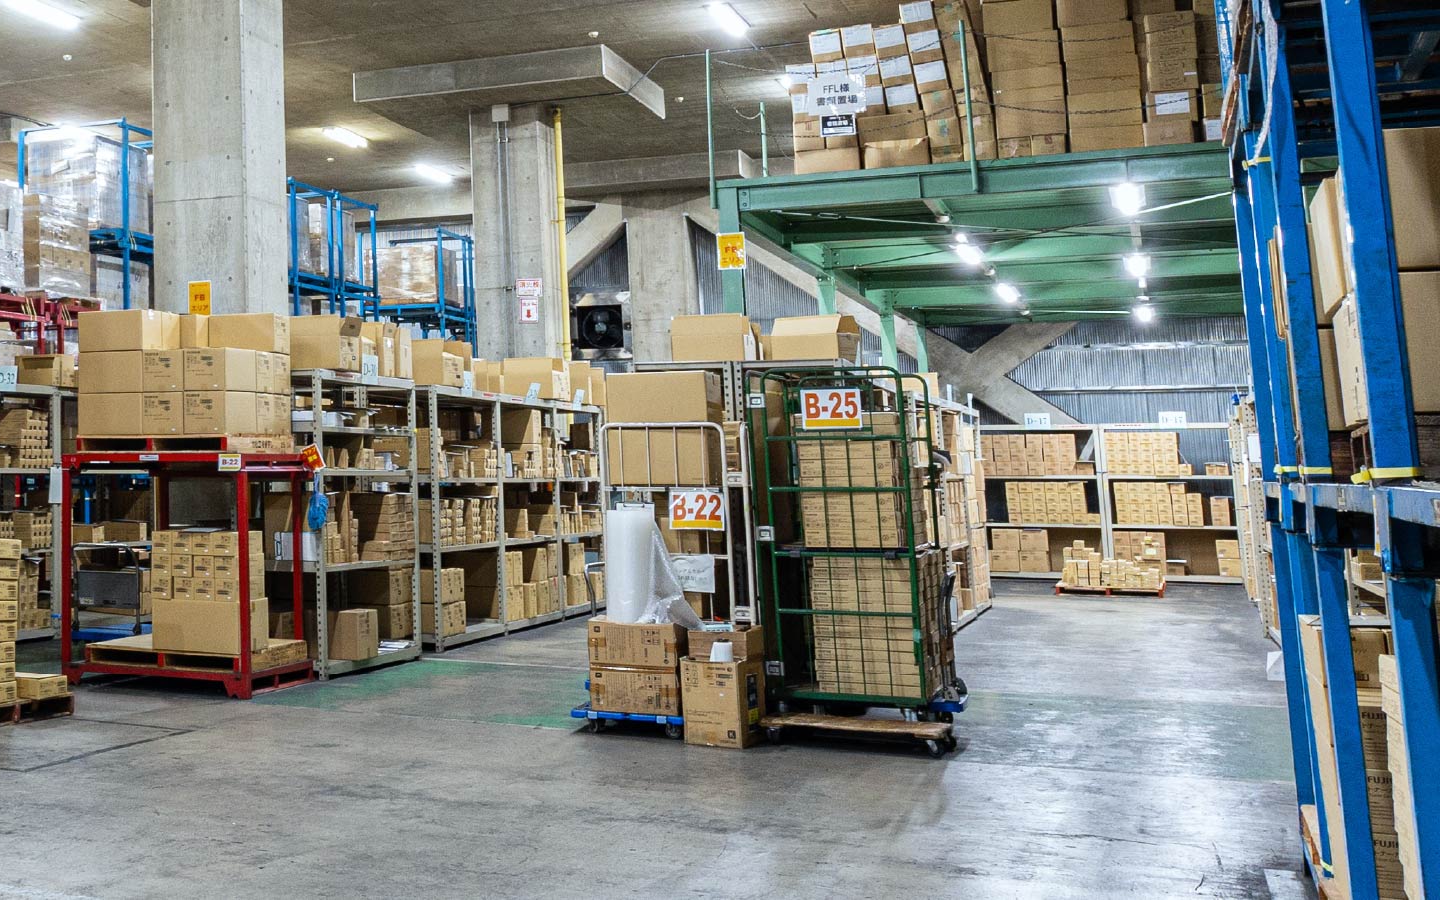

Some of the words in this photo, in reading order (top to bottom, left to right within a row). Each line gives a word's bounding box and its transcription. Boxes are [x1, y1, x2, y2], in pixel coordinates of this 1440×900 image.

[804, 391, 858, 419] B-25
[1027, 417, 1047, 425] D-17
[672, 494, 722, 521] B-22
